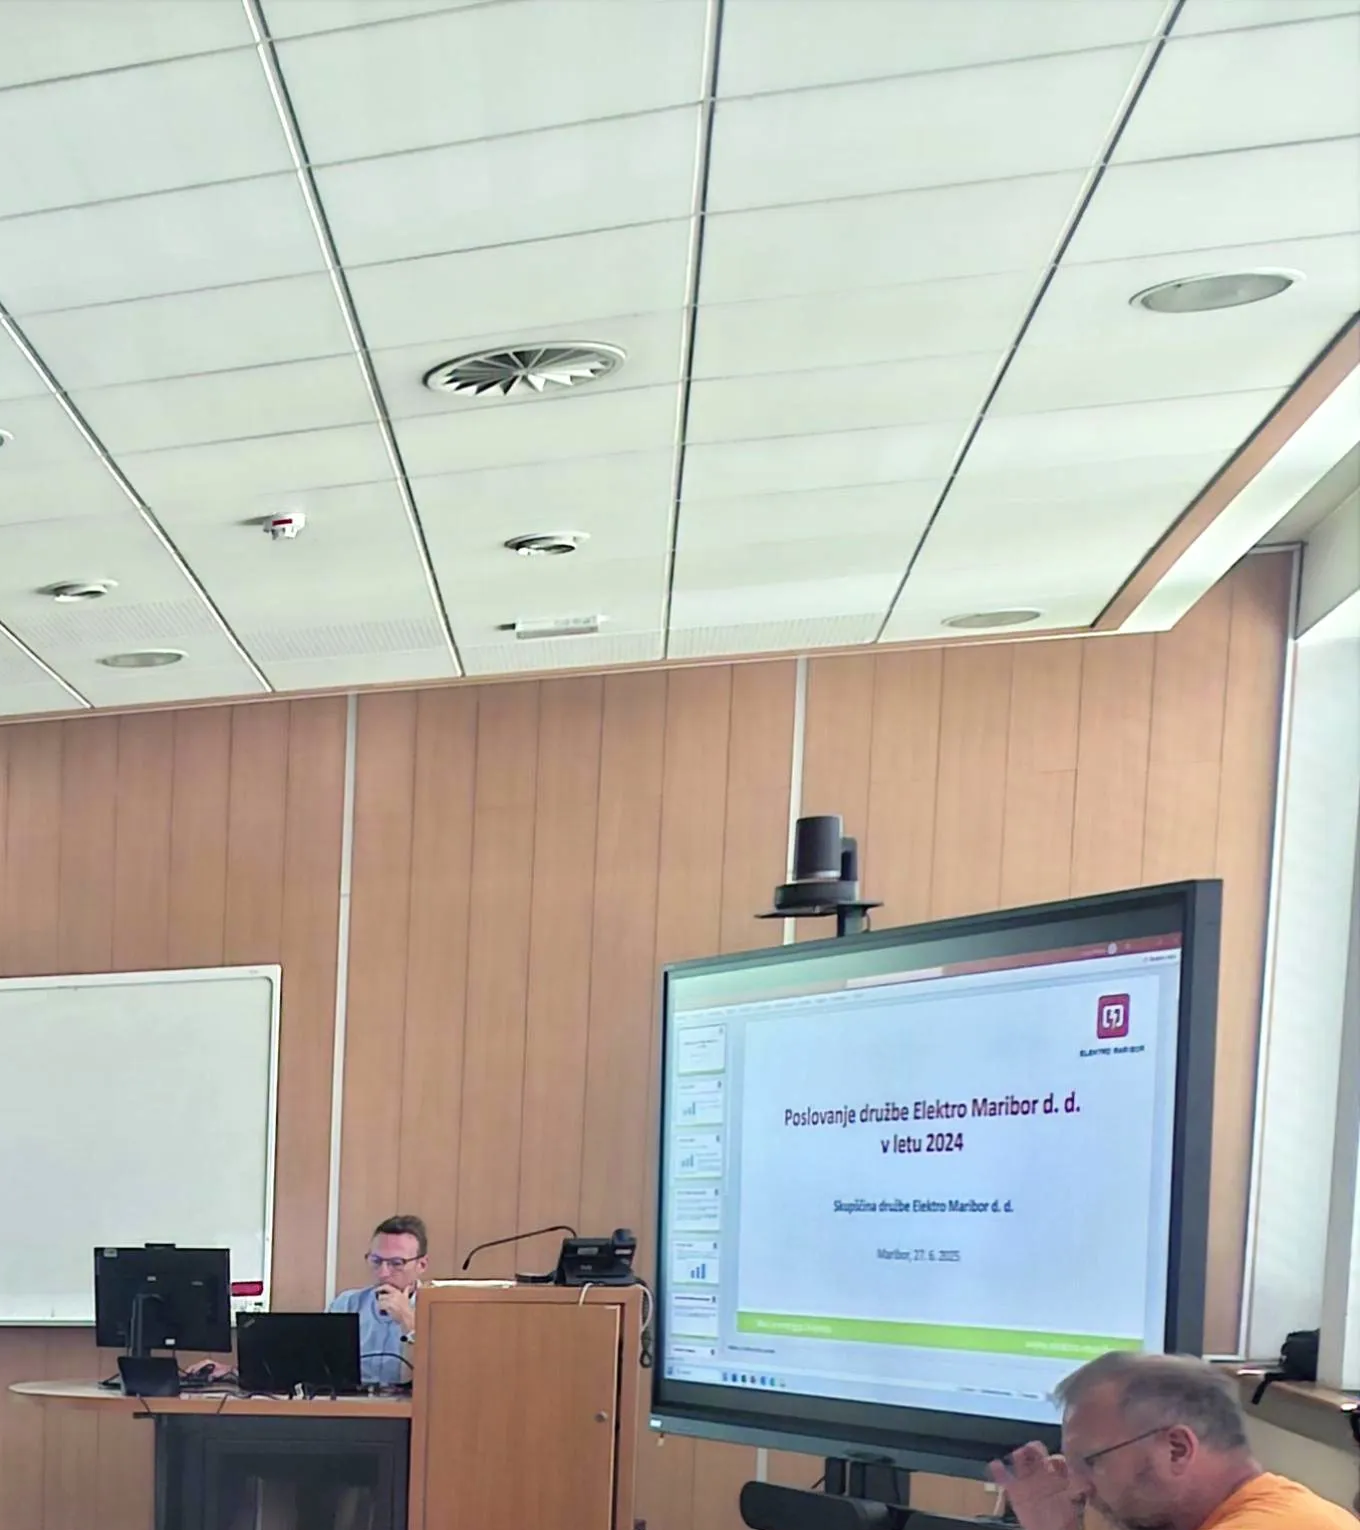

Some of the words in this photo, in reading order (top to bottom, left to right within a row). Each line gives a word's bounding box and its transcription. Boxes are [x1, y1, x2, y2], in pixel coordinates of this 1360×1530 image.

[784, 1105, 856, 1128] Poslovanje
[859, 1102, 909, 1123] družbe
[913, 1100, 967, 1120] Elektro
[971, 1094, 1039, 1117] Maribor
[1043, 1092, 1059, 1114] d.
[1064, 1091, 1080, 1113] d.
[880, 1139, 890, 1154] v
[893, 1134, 922, 1154] letu
[926, 1132, 964, 1152] 2024
